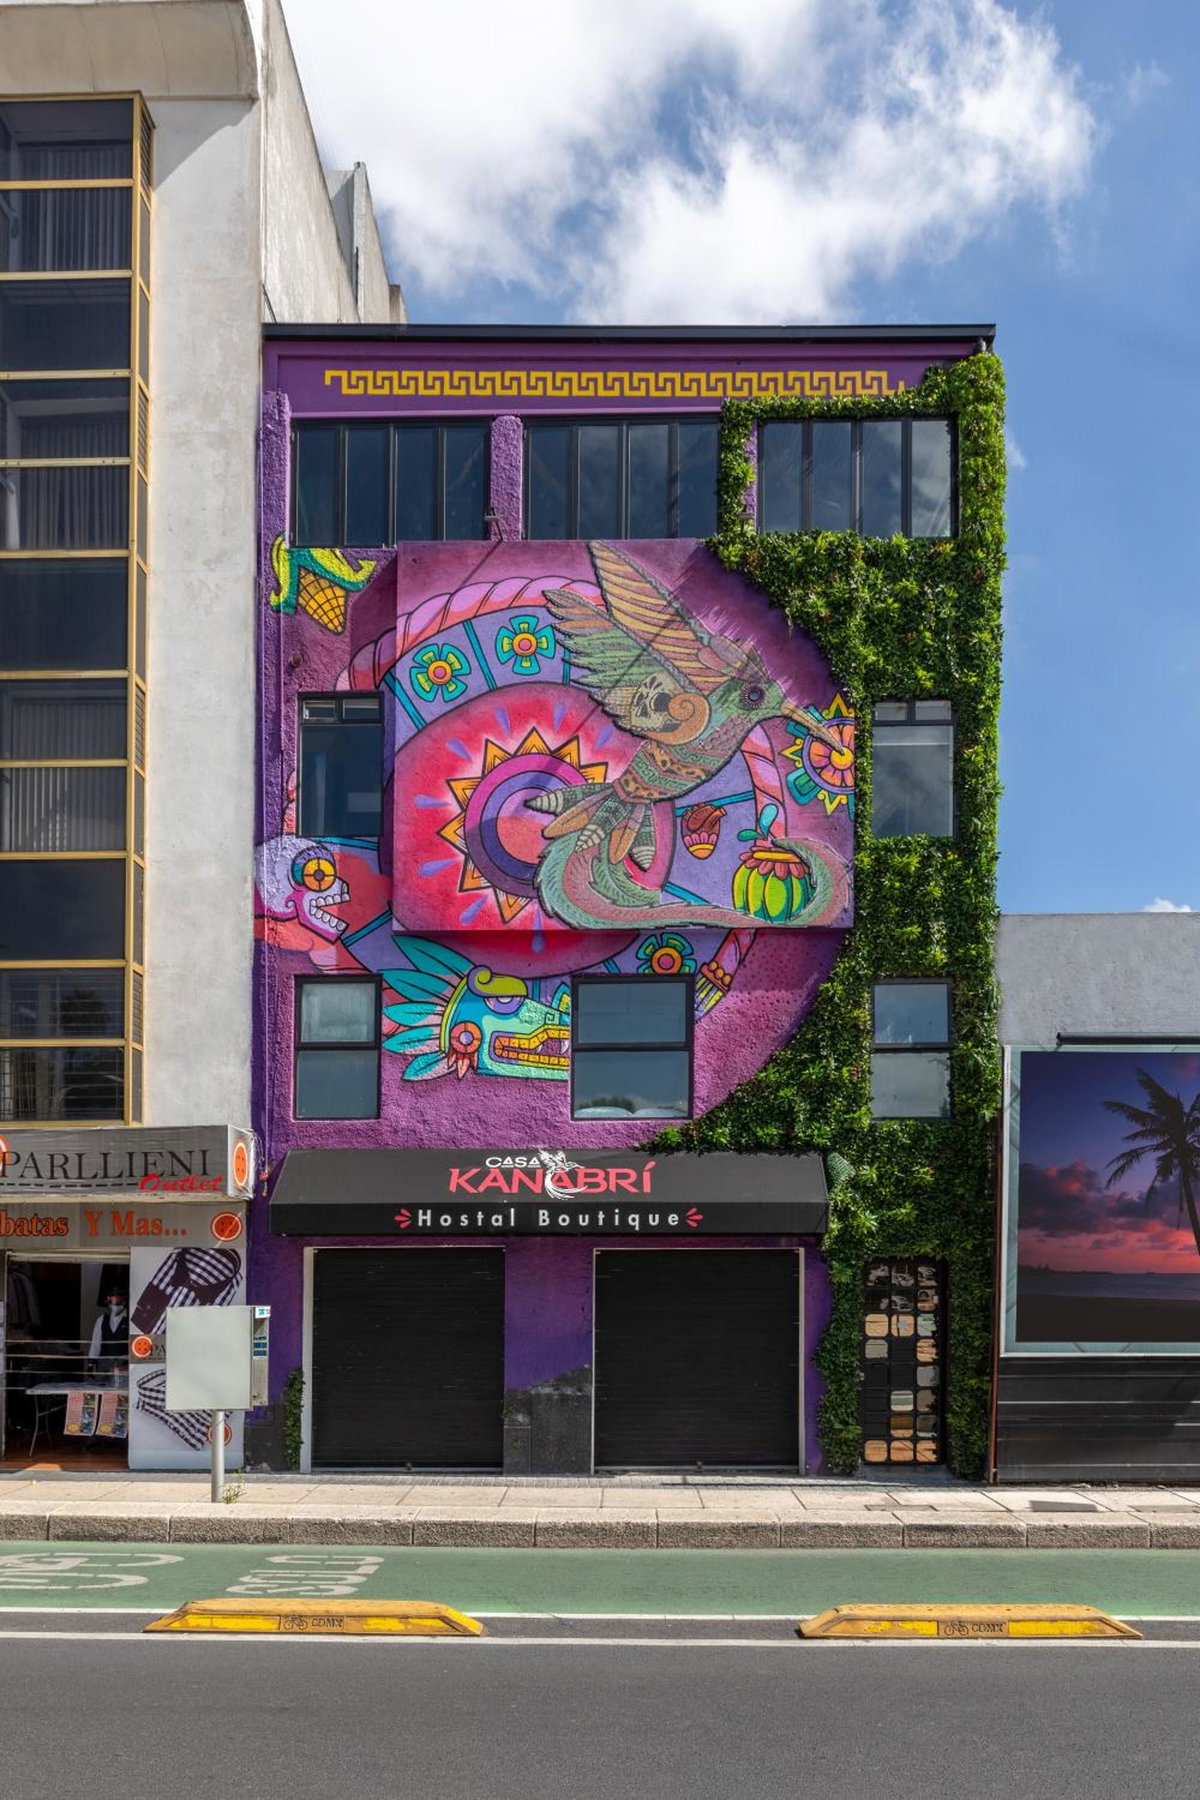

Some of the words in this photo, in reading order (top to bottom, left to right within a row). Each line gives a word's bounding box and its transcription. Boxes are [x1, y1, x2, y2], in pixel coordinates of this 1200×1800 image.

[0, 1149, 211, 1179] PARLLIENI
[485, 1156, 542, 1168] CASA
[139, 1173, 223, 1192] Outlet
[449, 1161, 657, 1194] KANABRÍ
[84, 1210, 103, 1236] Y
[417, 1208, 515, 1227] Hostal
[538, 1208, 680, 1230] Boutique
